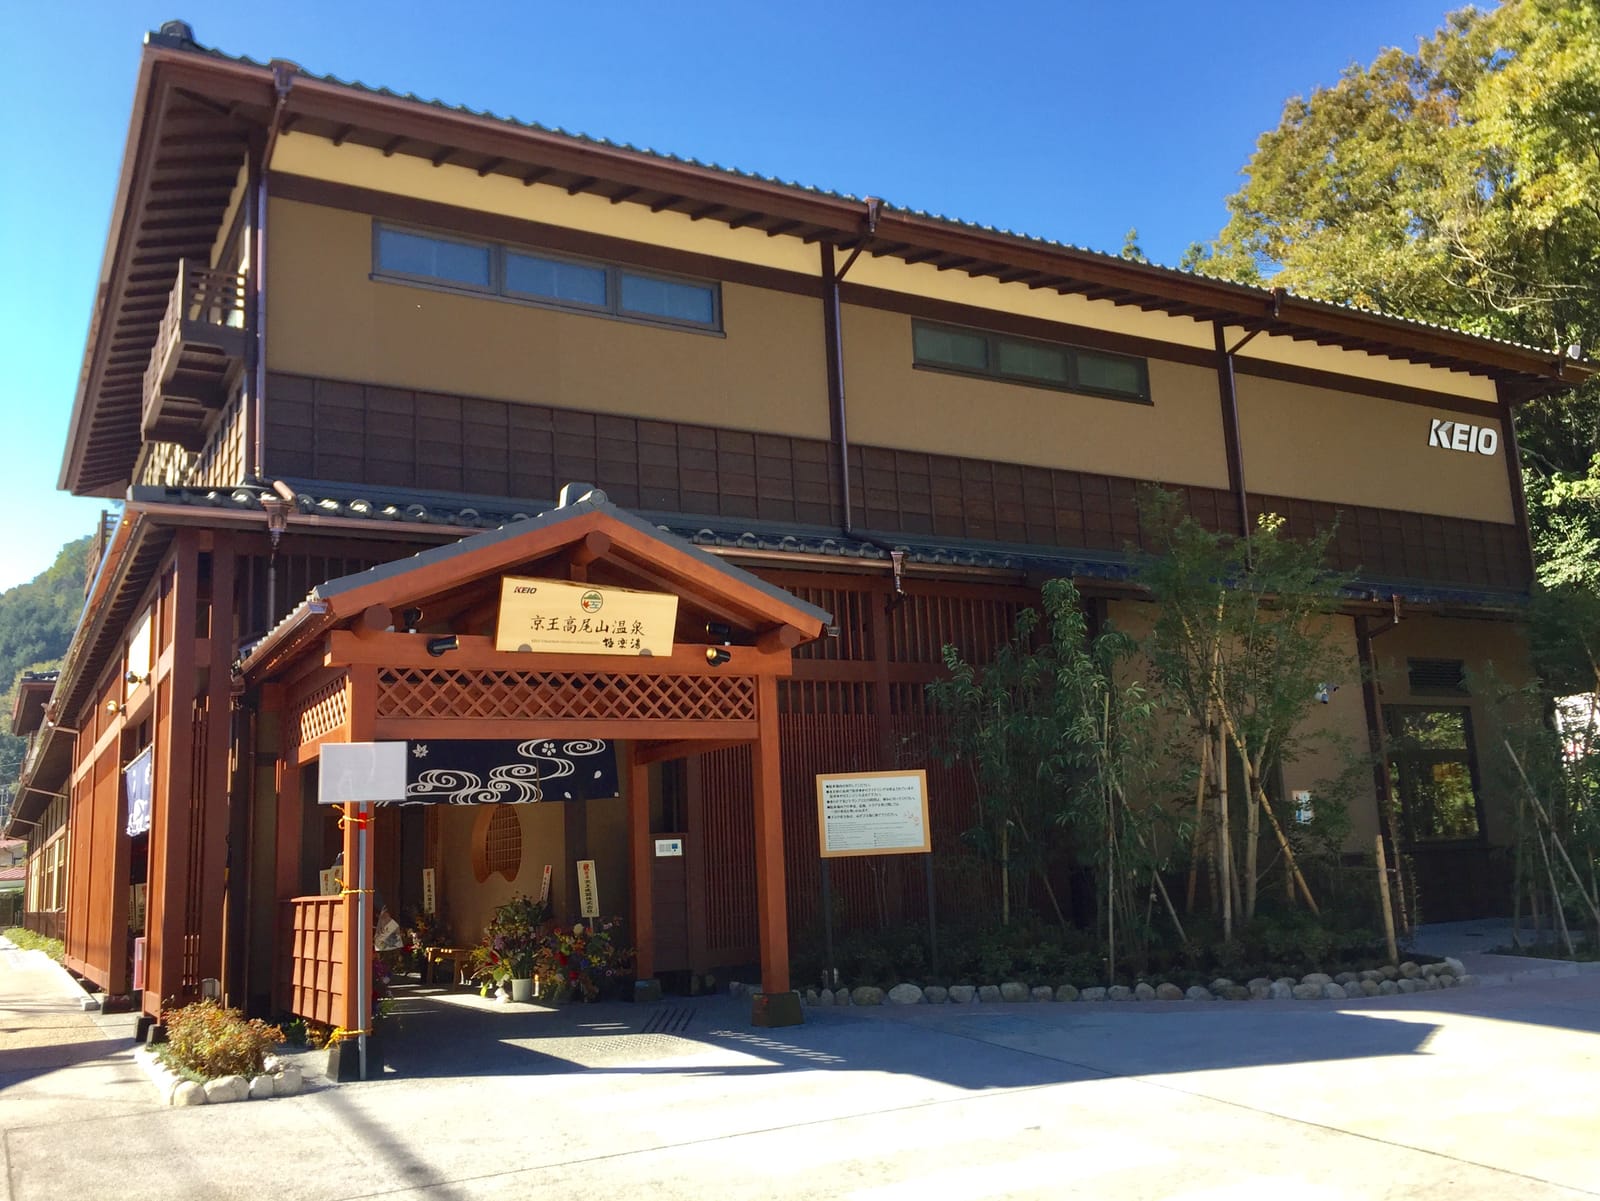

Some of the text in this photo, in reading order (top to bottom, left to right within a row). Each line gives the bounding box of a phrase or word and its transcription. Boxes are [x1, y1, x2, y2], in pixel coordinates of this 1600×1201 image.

[1428, 418, 1498, 456] KEIO
[514, 586, 537, 594] KEIO
[530, 614, 645, 636] 京王高尾山温泉
